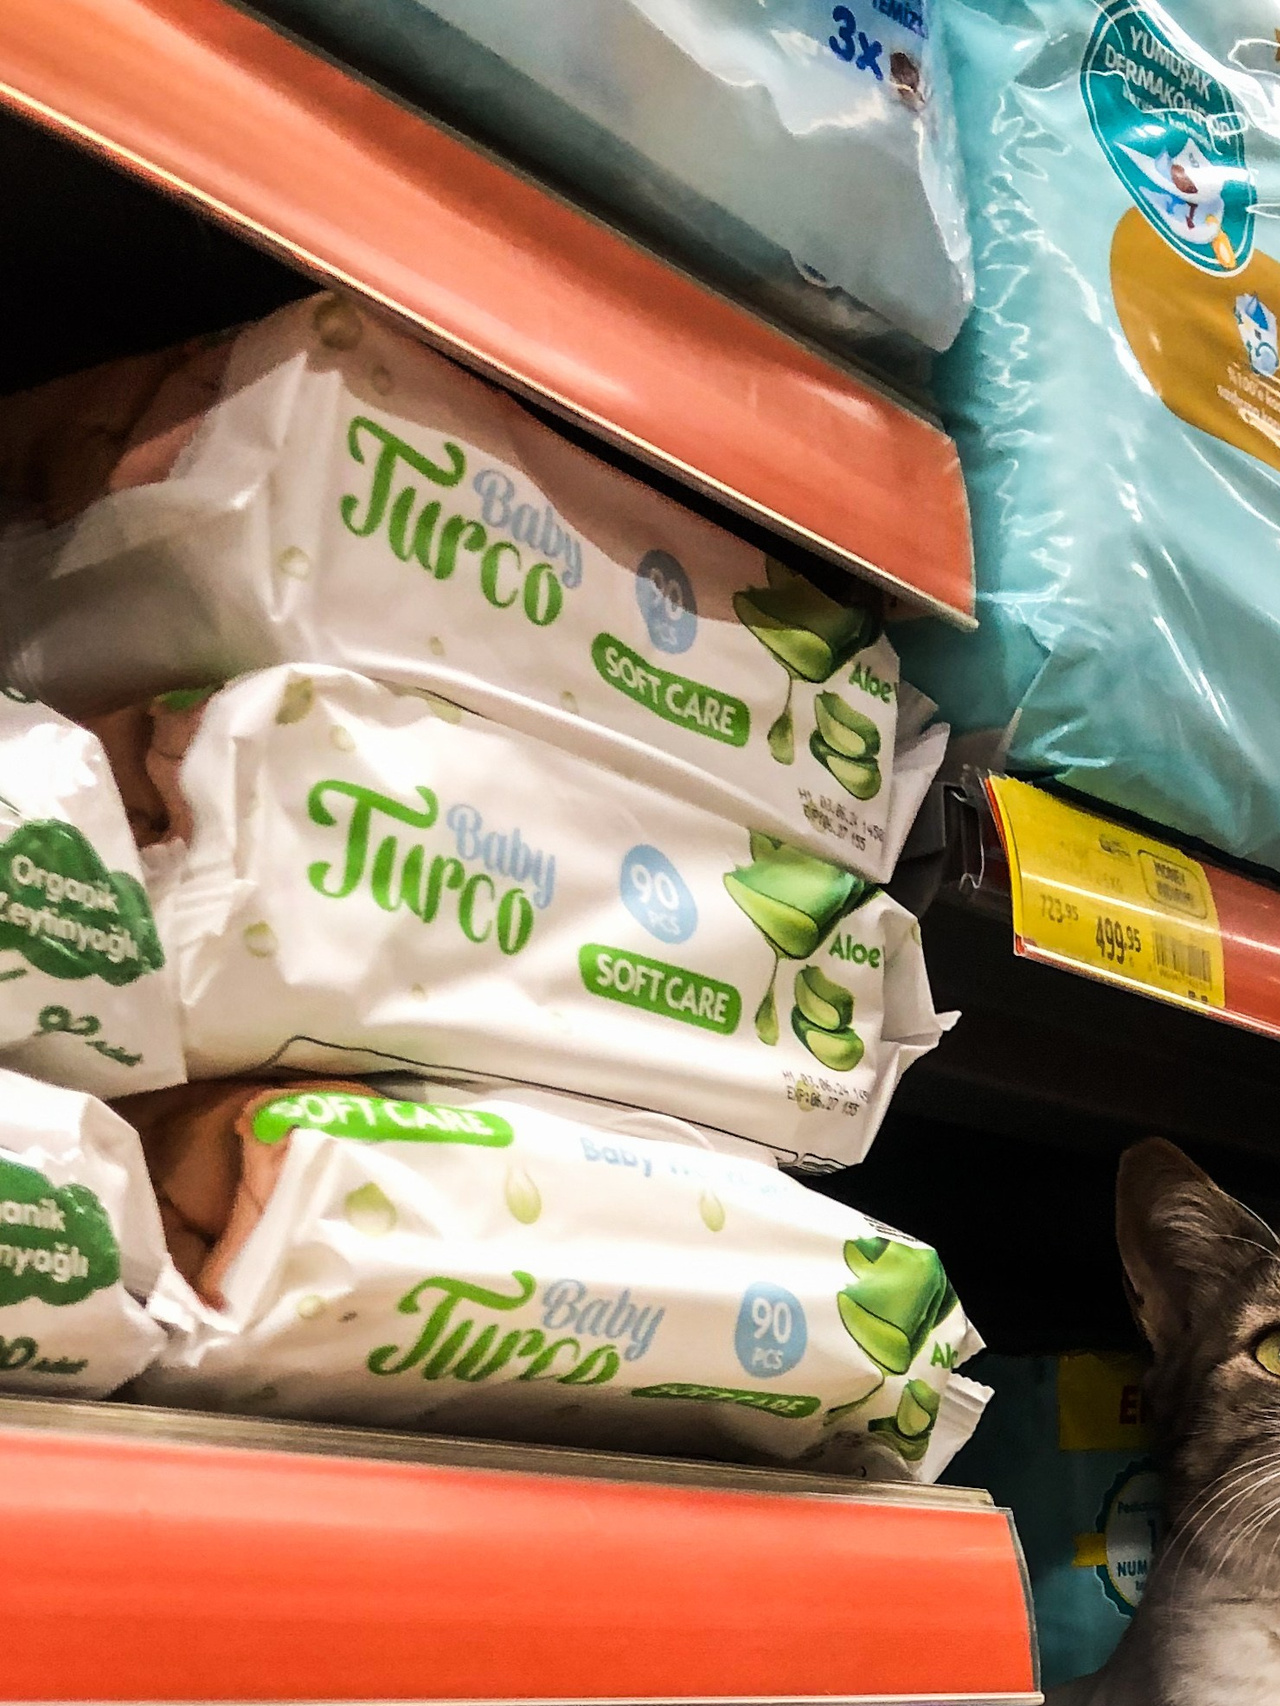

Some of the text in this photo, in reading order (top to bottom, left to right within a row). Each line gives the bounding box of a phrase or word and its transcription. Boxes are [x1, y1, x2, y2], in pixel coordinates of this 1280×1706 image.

[1130, 26, 1213, 101] YUMUŞAK
[340, 415, 564, 627] Turco
[473, 468, 583, 589] Baby
[604, 646, 736, 738] SOFT CARE
[848, 661, 892, 704] Aloe
[11, 854, 119, 914] Organik
[307, 779, 535, 956] Turco
[446, 803, 556, 910] Baby
[629, 863, 680, 911] 90
[828, 932, 883, 970] Aloe
[1095, 915, 1143, 965] 499.95
[596, 953, 731, 1026] SOFT CARE
[270, 1094, 493, 1136] SOFT CARE
[0, 1198, 66, 1233] anik
[0, 1241, 90, 1284] nyağı
[367, 1270, 621, 1386] Turco
[542, 1276, 665, 1362] Baby
[751, 1298, 793, 1345] 90
[751, 1350, 783, 1372] PCS
